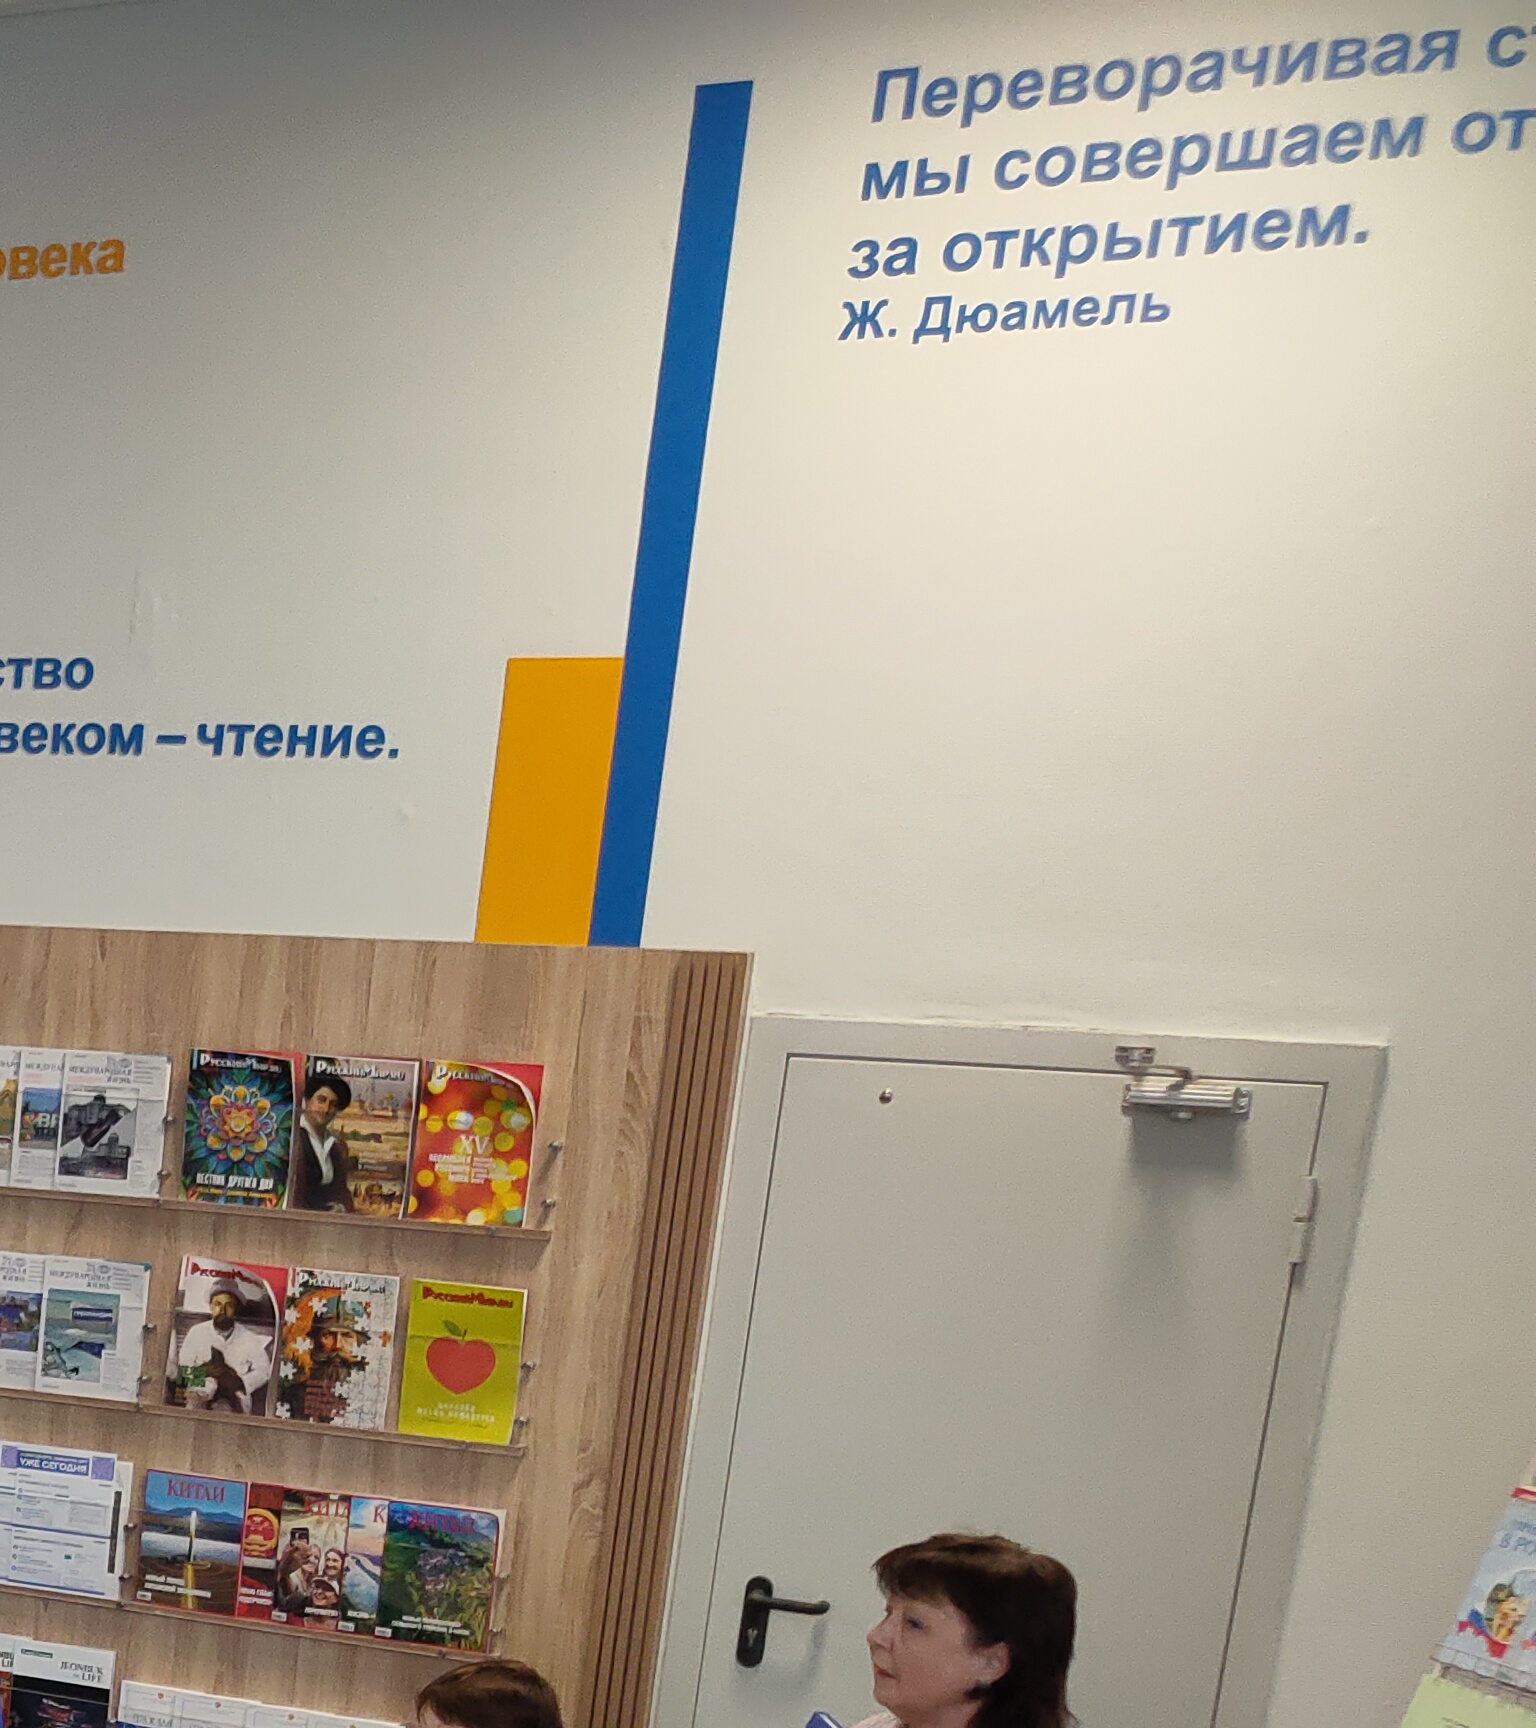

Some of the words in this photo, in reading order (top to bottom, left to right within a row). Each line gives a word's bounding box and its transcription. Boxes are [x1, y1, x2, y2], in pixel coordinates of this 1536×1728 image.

[873, 29, 1460, 127] Переворачивая
[1487, 24, 1536, 68] с
[862, 154, 971, 201] мы
[995, 116, 1425, 190] совершаем
[848, 235, 919, 278] за
[943, 203, 1368, 277] открытием.
[840, 299, 897, 340] Ж.
[912, 292, 1171, 344] Дюамель
[197, 722, 400, 760] чтение.
[19, 1458, 41, 1467] УЖЕ
[43, 1460, 87, 1473] СЕГОДНЯ
